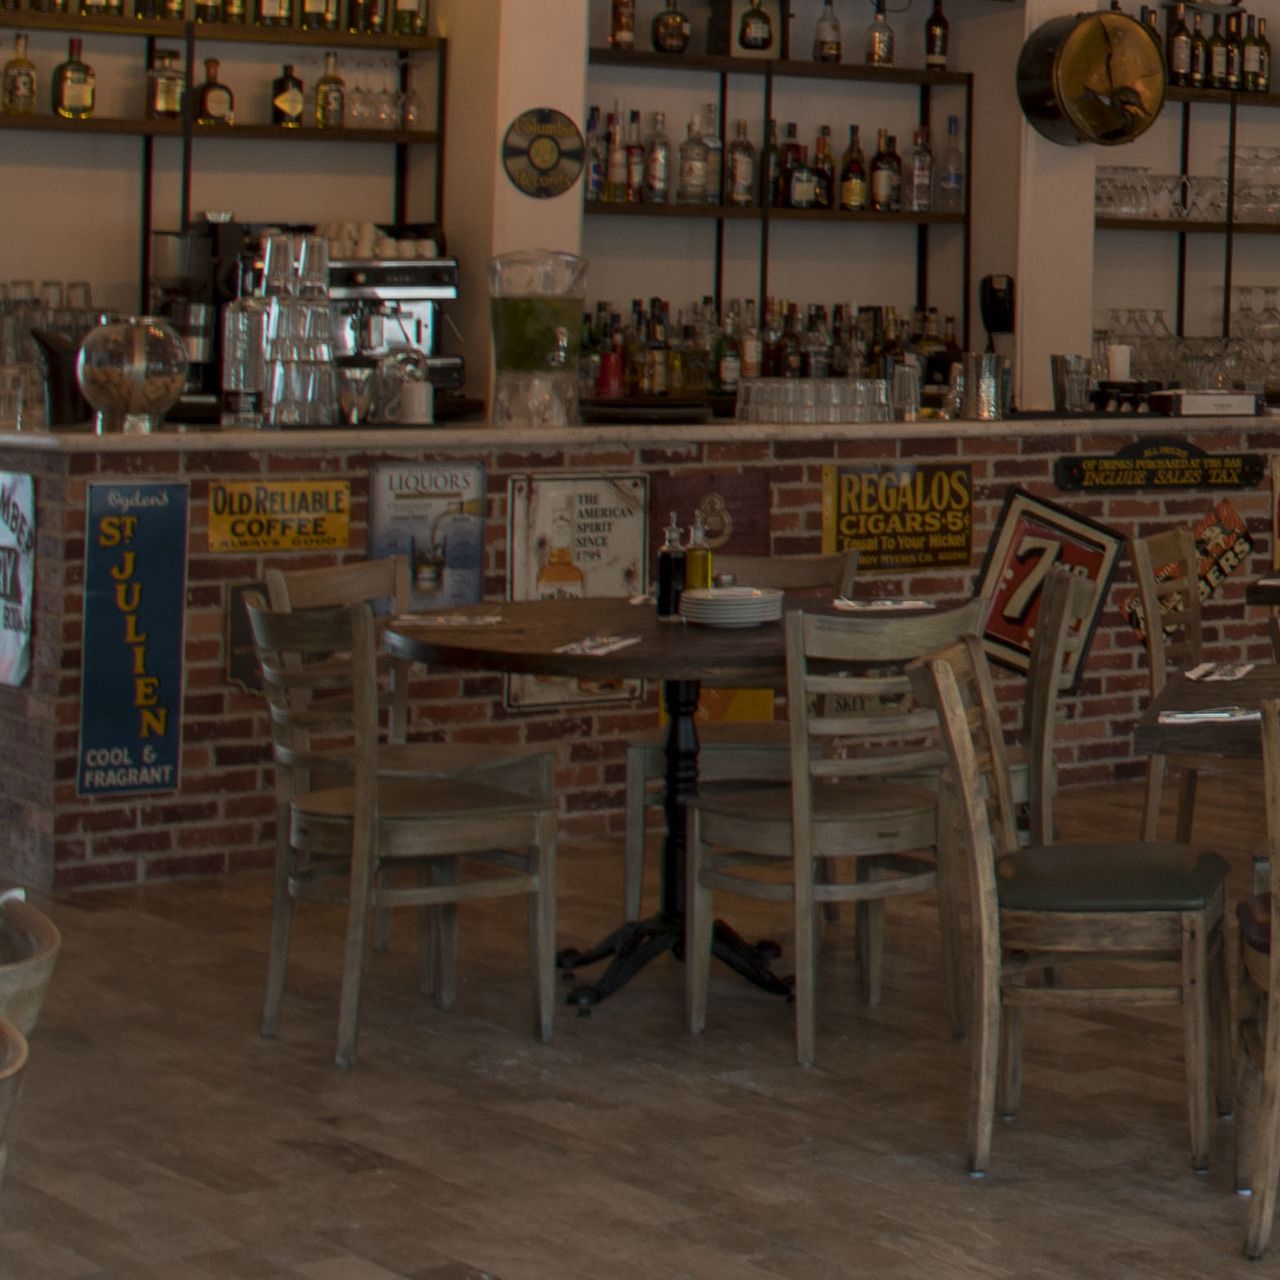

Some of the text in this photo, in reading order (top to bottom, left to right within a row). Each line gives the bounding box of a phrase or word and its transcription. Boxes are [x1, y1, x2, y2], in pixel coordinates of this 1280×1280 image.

[387, 472, 472, 492] LIQUORS
[1081, 469, 1241, 486] INCLUDE SALES TAX
[212, 486, 346, 516] OLD RELIABLE
[577, 493, 598, 505] THE
[840, 470, 970, 513] REGALOS
[576, 507, 634, 520] AMERICAN
[230, 518, 328, 538] COFFEE
[576, 522, 613, 534] SPIRIT
[576, 536, 609, 547] SINCE
[897, 534, 926, 550] Your
[1002, 535, 1061, 619] 7
[111, 552, 168, 739] JULIEN
[85, 746, 157, 767] COOL &
[83, 765, 174, 789] FRAGRANT
